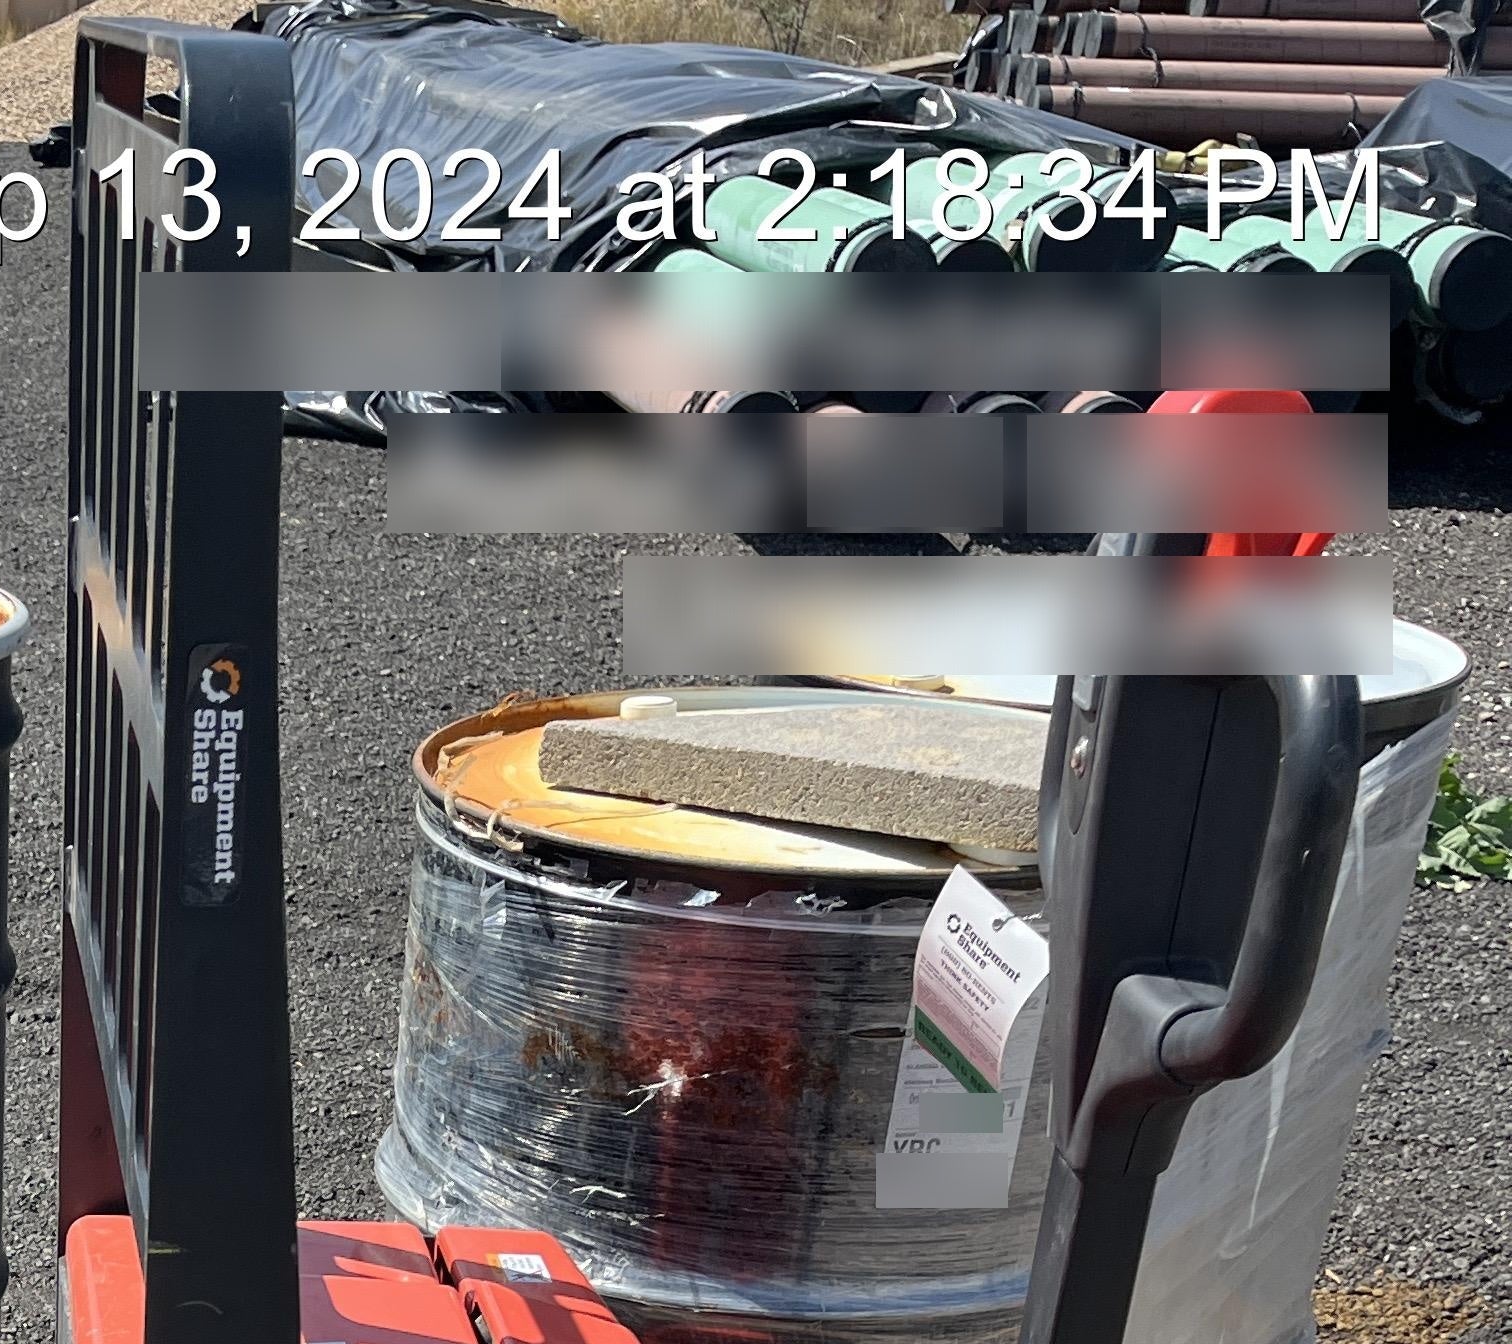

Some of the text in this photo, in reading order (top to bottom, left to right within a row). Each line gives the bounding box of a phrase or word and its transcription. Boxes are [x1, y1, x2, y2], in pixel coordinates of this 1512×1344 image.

[191, 708, 217, 804] Share
[213, 709, 244, 884] Equipment
[957, 934, 988, 970] Share
[963, 922, 1021, 984] Equipment
